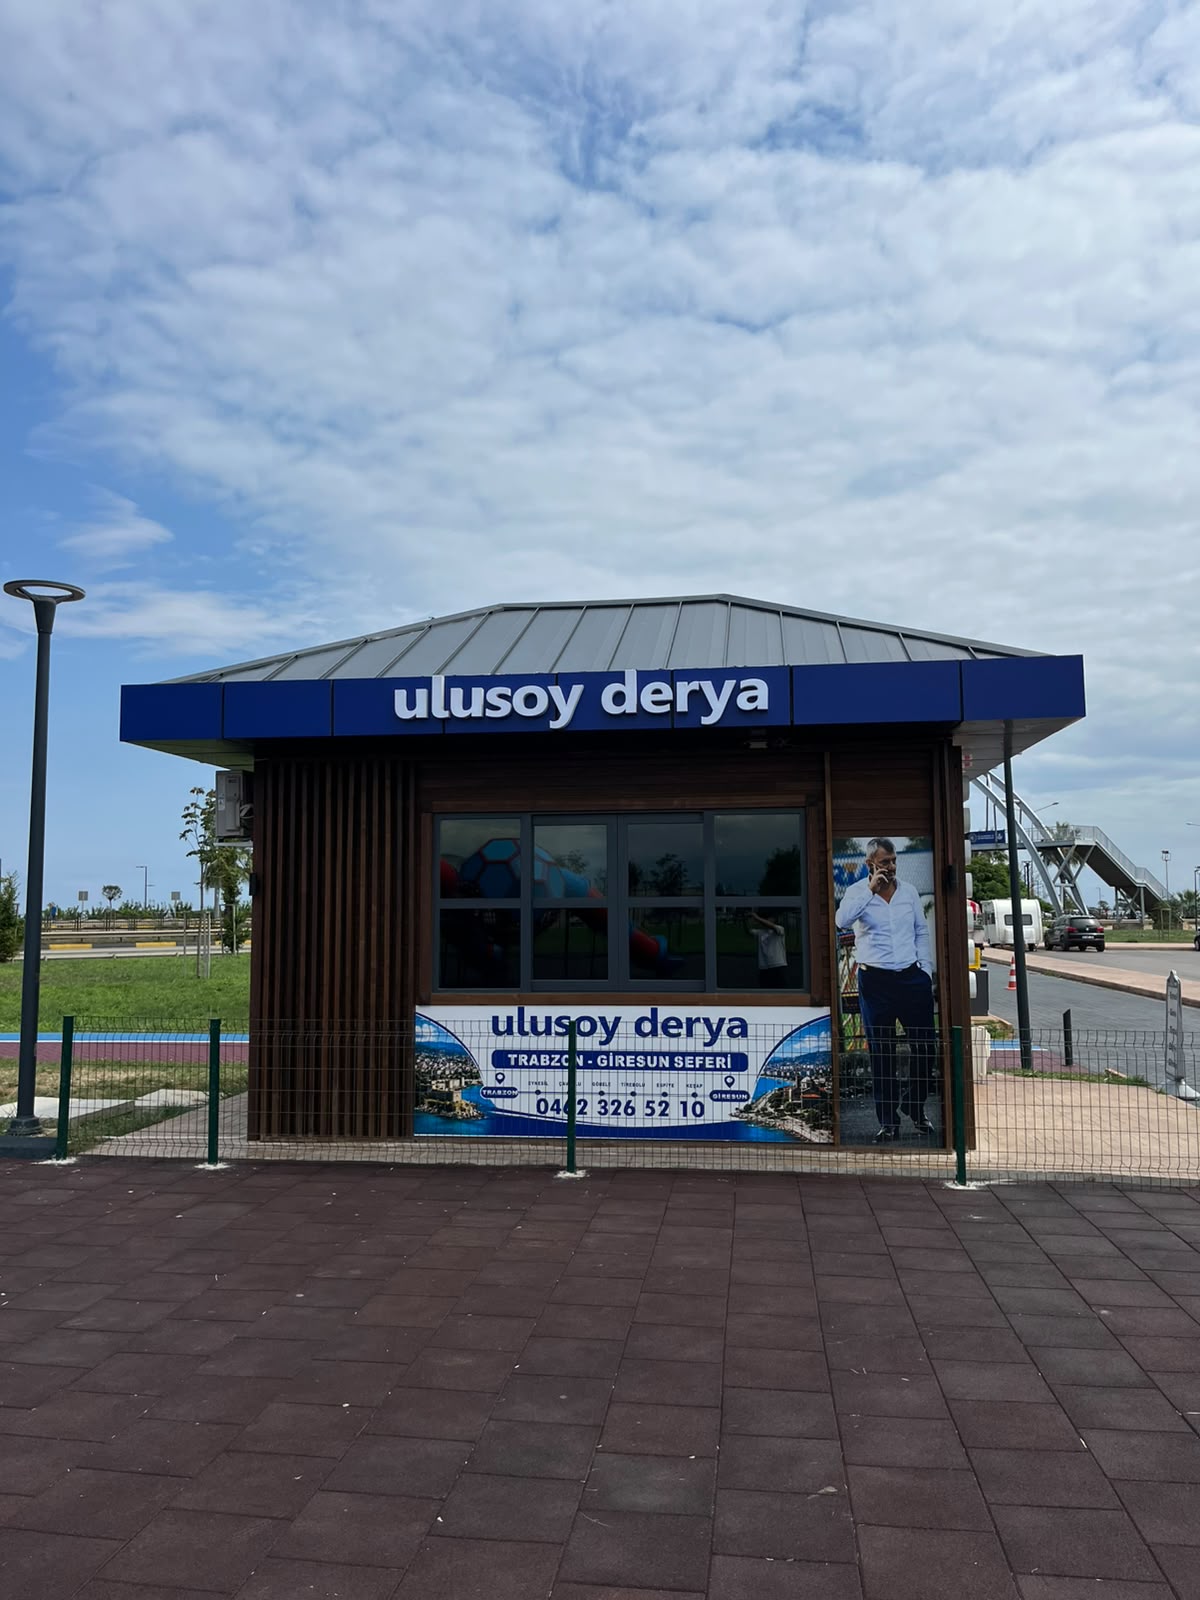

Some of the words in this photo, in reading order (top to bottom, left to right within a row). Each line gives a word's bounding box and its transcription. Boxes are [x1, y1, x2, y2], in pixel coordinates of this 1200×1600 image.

[393, 675, 585, 730] ulusoy
[600, 669, 770, 725] derya
[491, 1006, 622, 1046] ulusoy
[634, 1007, 748, 1047] derya
[507, 1053, 584, 1067] TRABZON
[596, 1052, 670, 1068] GİRESUN
[673, 1054, 732, 1069] SEFERİ
[482, 1089, 518, 1097] TRABZON
[712, 1091, 748, 1101] GİRESUN
[597, 1099, 636, 1117] 326
[645, 1100, 670, 1118] 52
[680, 1101, 705, 1119] 10
